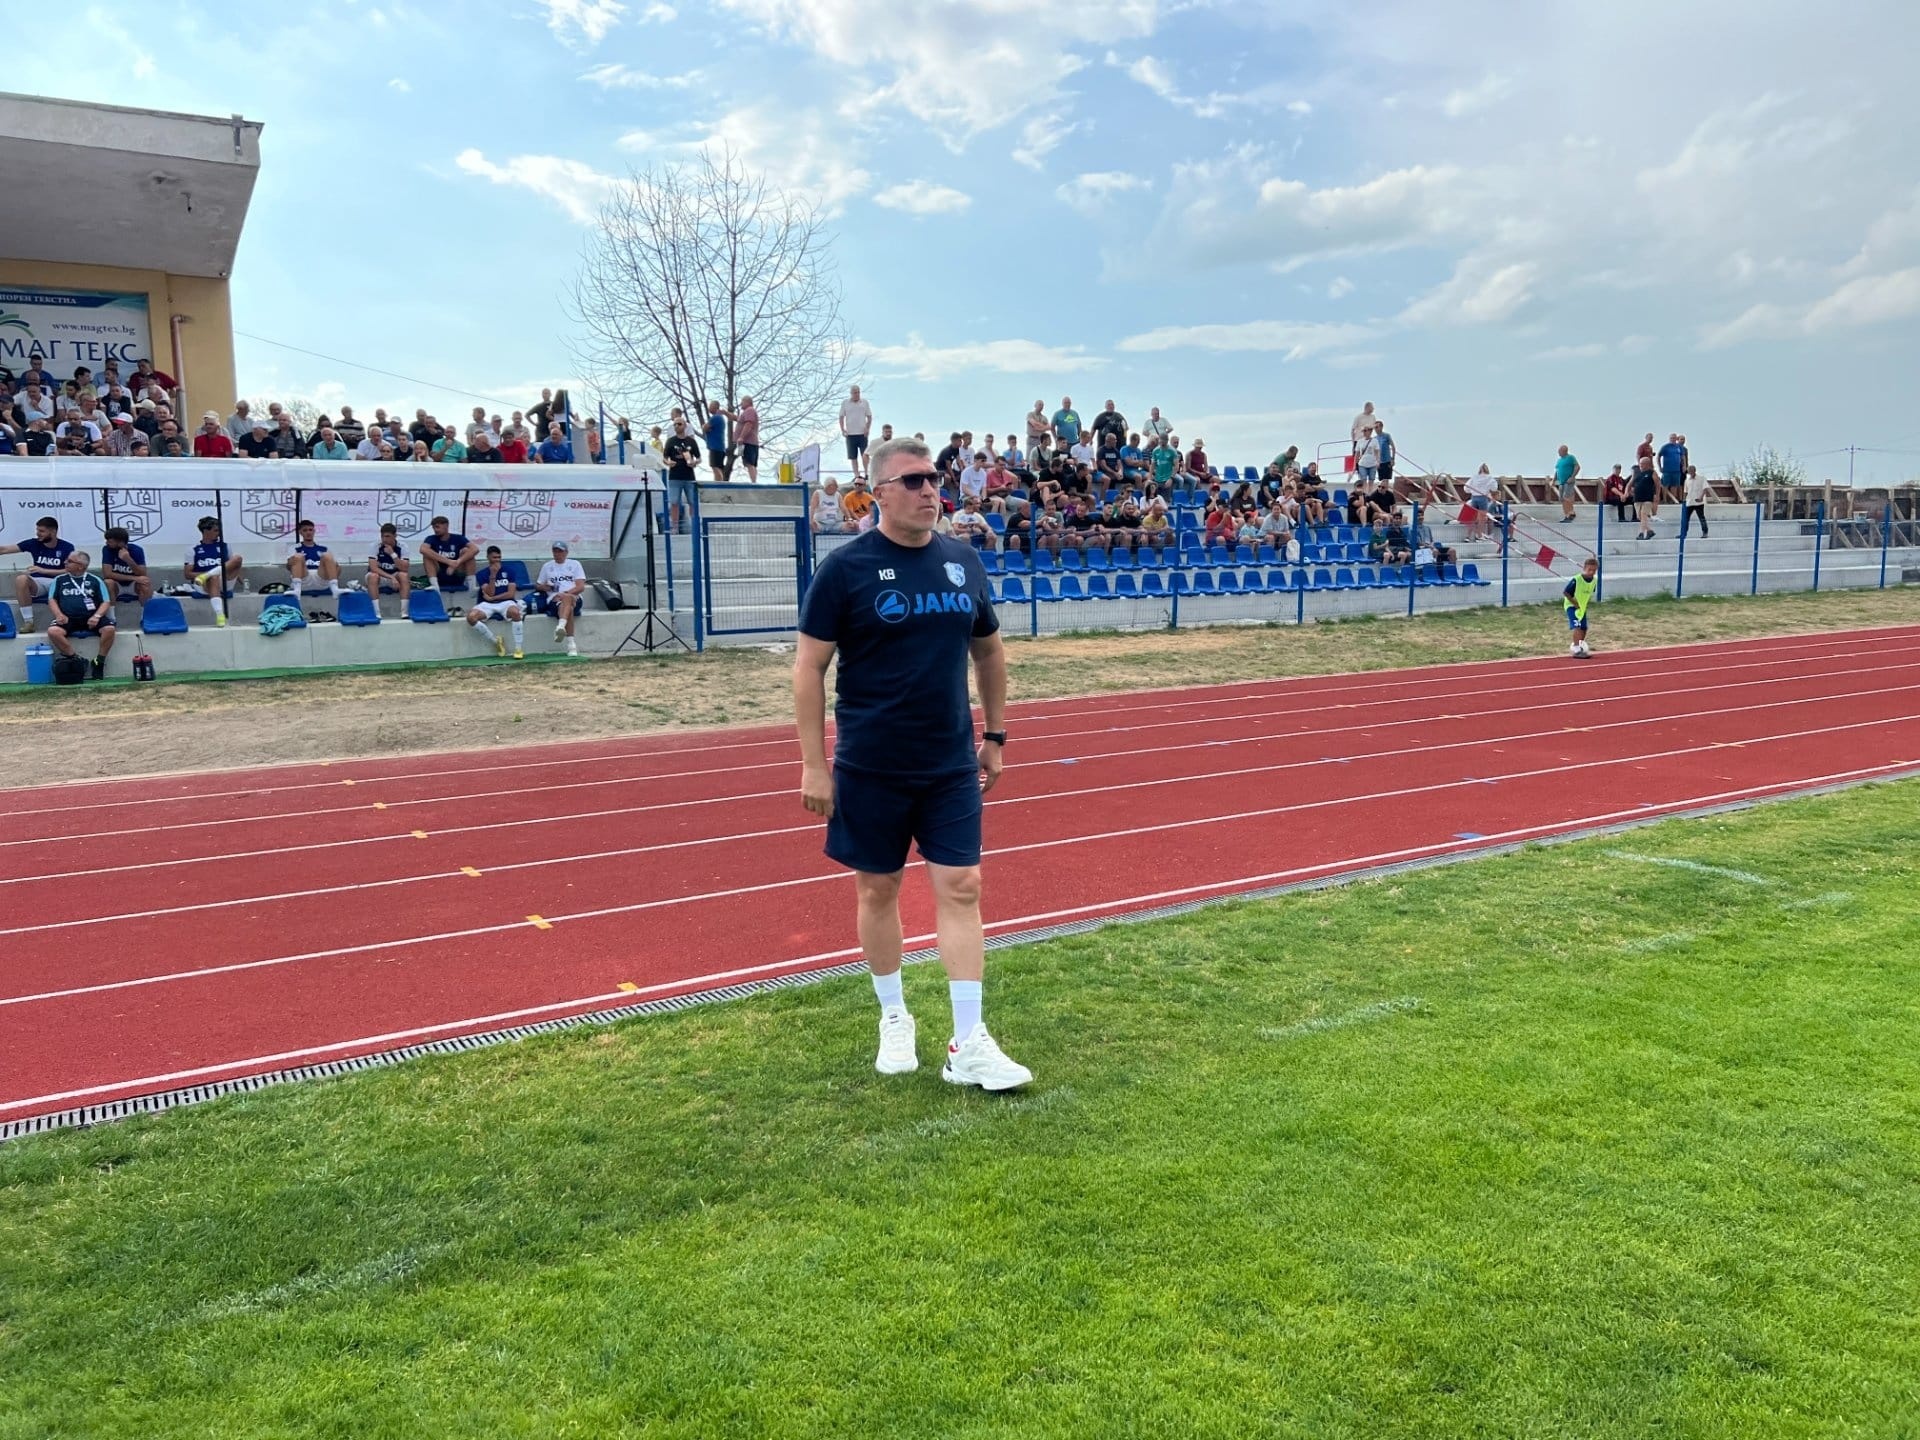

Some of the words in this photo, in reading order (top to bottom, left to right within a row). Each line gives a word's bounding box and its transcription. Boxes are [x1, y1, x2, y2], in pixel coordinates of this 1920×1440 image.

[52, 322, 137, 336] www.magtex.bg
[0, 338, 62, 360] МАГ
[69, 341, 138, 364] ТЕКС
[36, 555, 61, 566] JAKO
[197, 557, 222, 567] efbe
[878, 568, 896, 581] KB
[913, 591, 972, 614] JAKO
